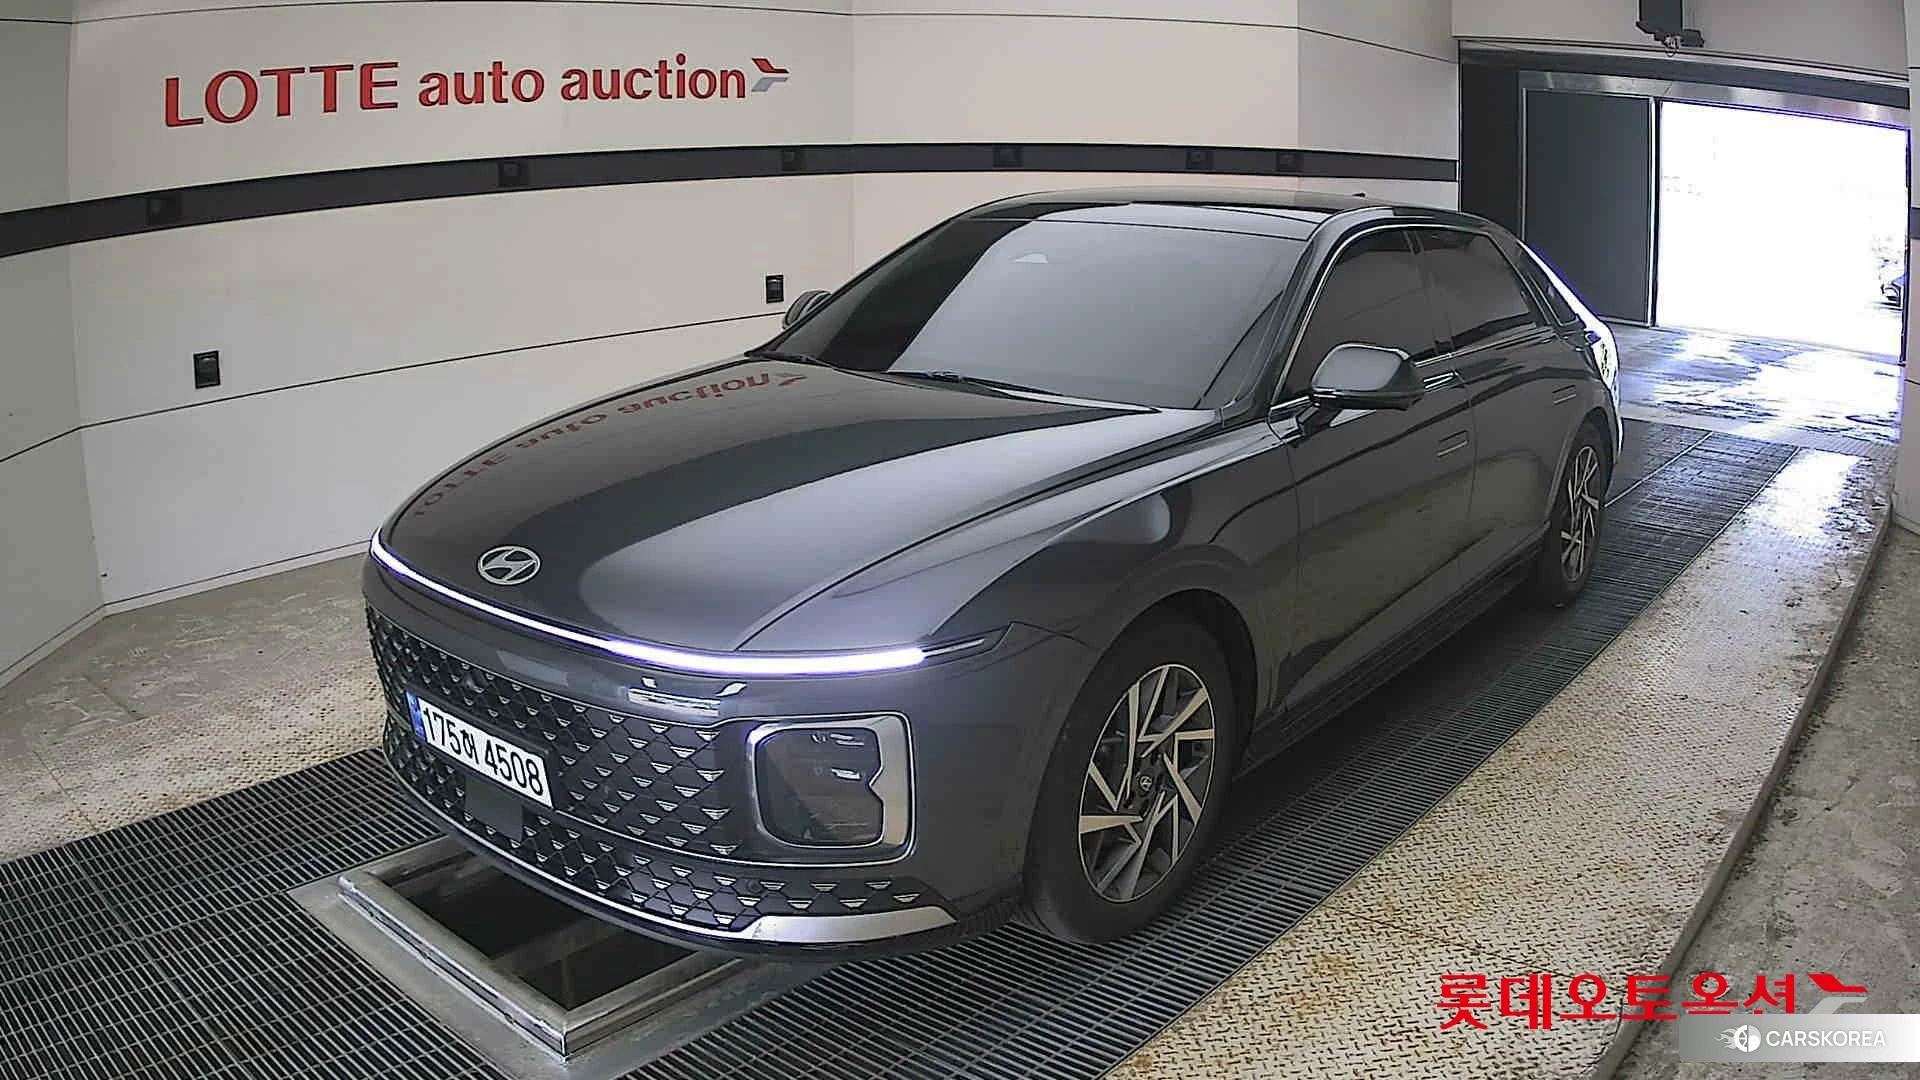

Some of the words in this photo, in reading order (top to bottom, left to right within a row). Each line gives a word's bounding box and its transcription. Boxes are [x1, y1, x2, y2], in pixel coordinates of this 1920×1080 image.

[165, 62, 398, 128] LOTTE
[418, 60, 545, 107] auto
[560, 53, 747, 101] auction
[484, 738, 543, 796] 4508
